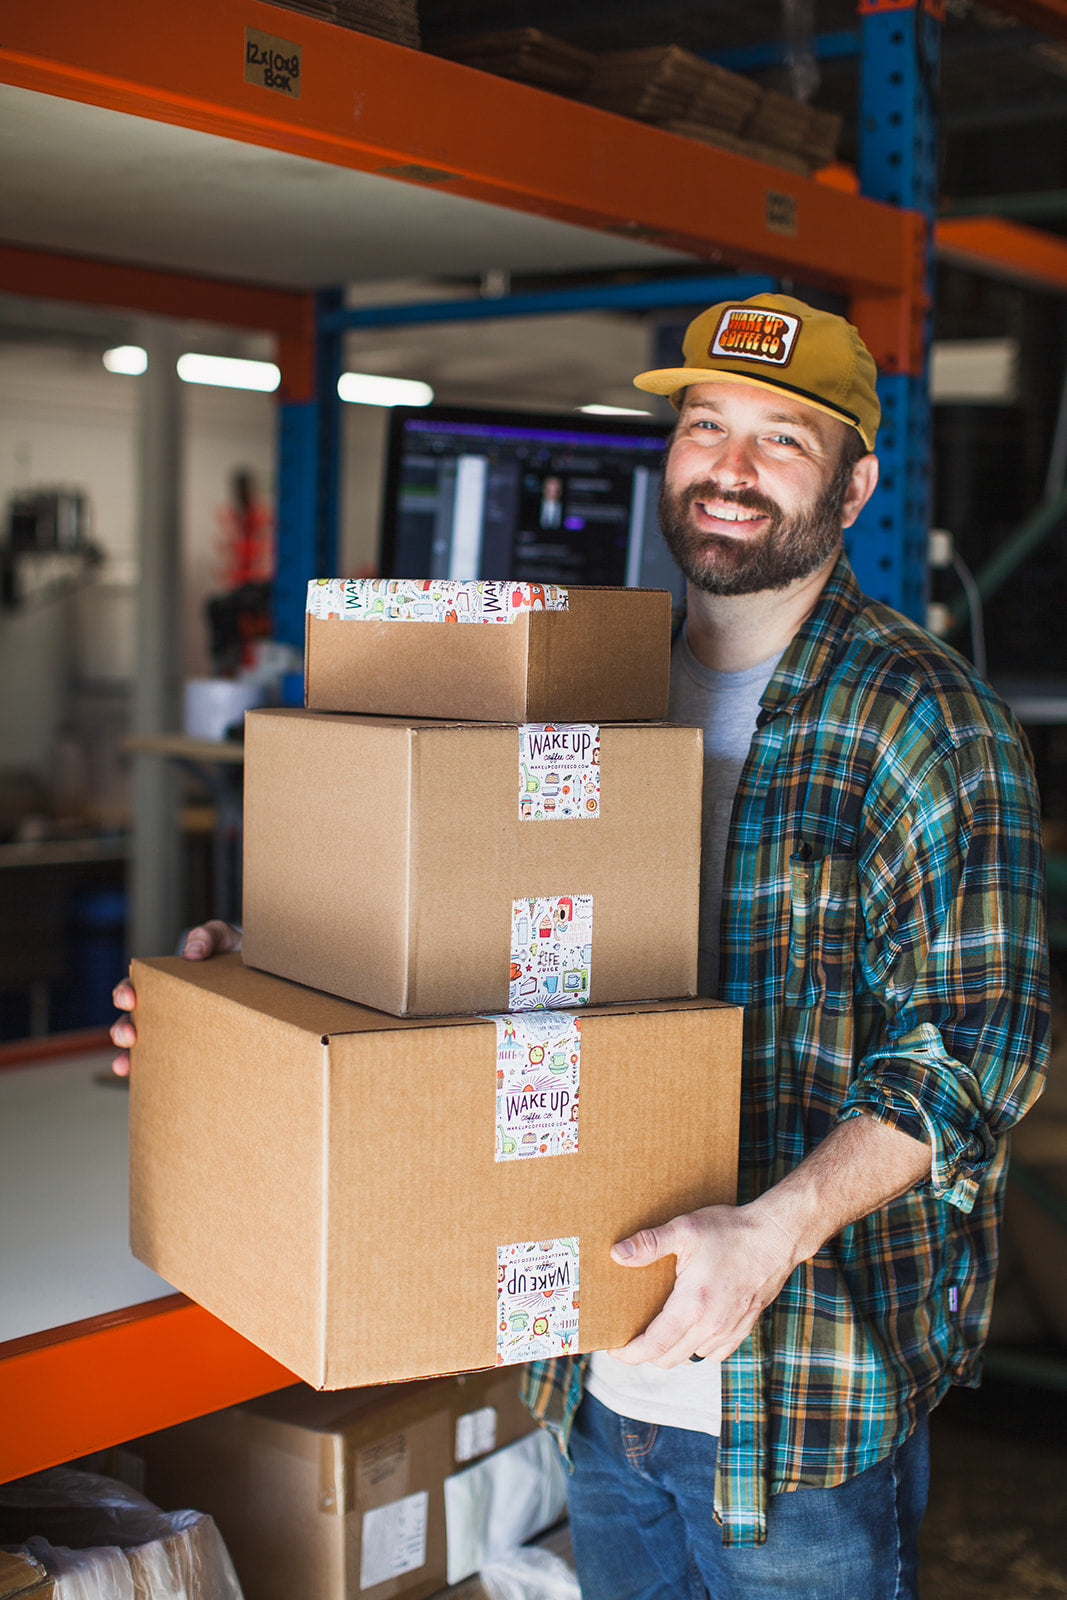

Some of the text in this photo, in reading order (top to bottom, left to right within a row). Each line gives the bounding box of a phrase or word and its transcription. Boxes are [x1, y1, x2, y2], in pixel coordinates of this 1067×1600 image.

[728, 312, 784, 335] WAKE UP
[719, 329, 780, 354] COFFEE CO
[528, 732, 591, 760] WAKE UP
[543, 752, 565, 764] coffee
[537, 950, 560, 967] LIFE
[506, 1090, 570, 1121] WAKE UP
[521, 1112, 541, 1124] coffee
[507, 1261, 570, 1295] WAKE UP
